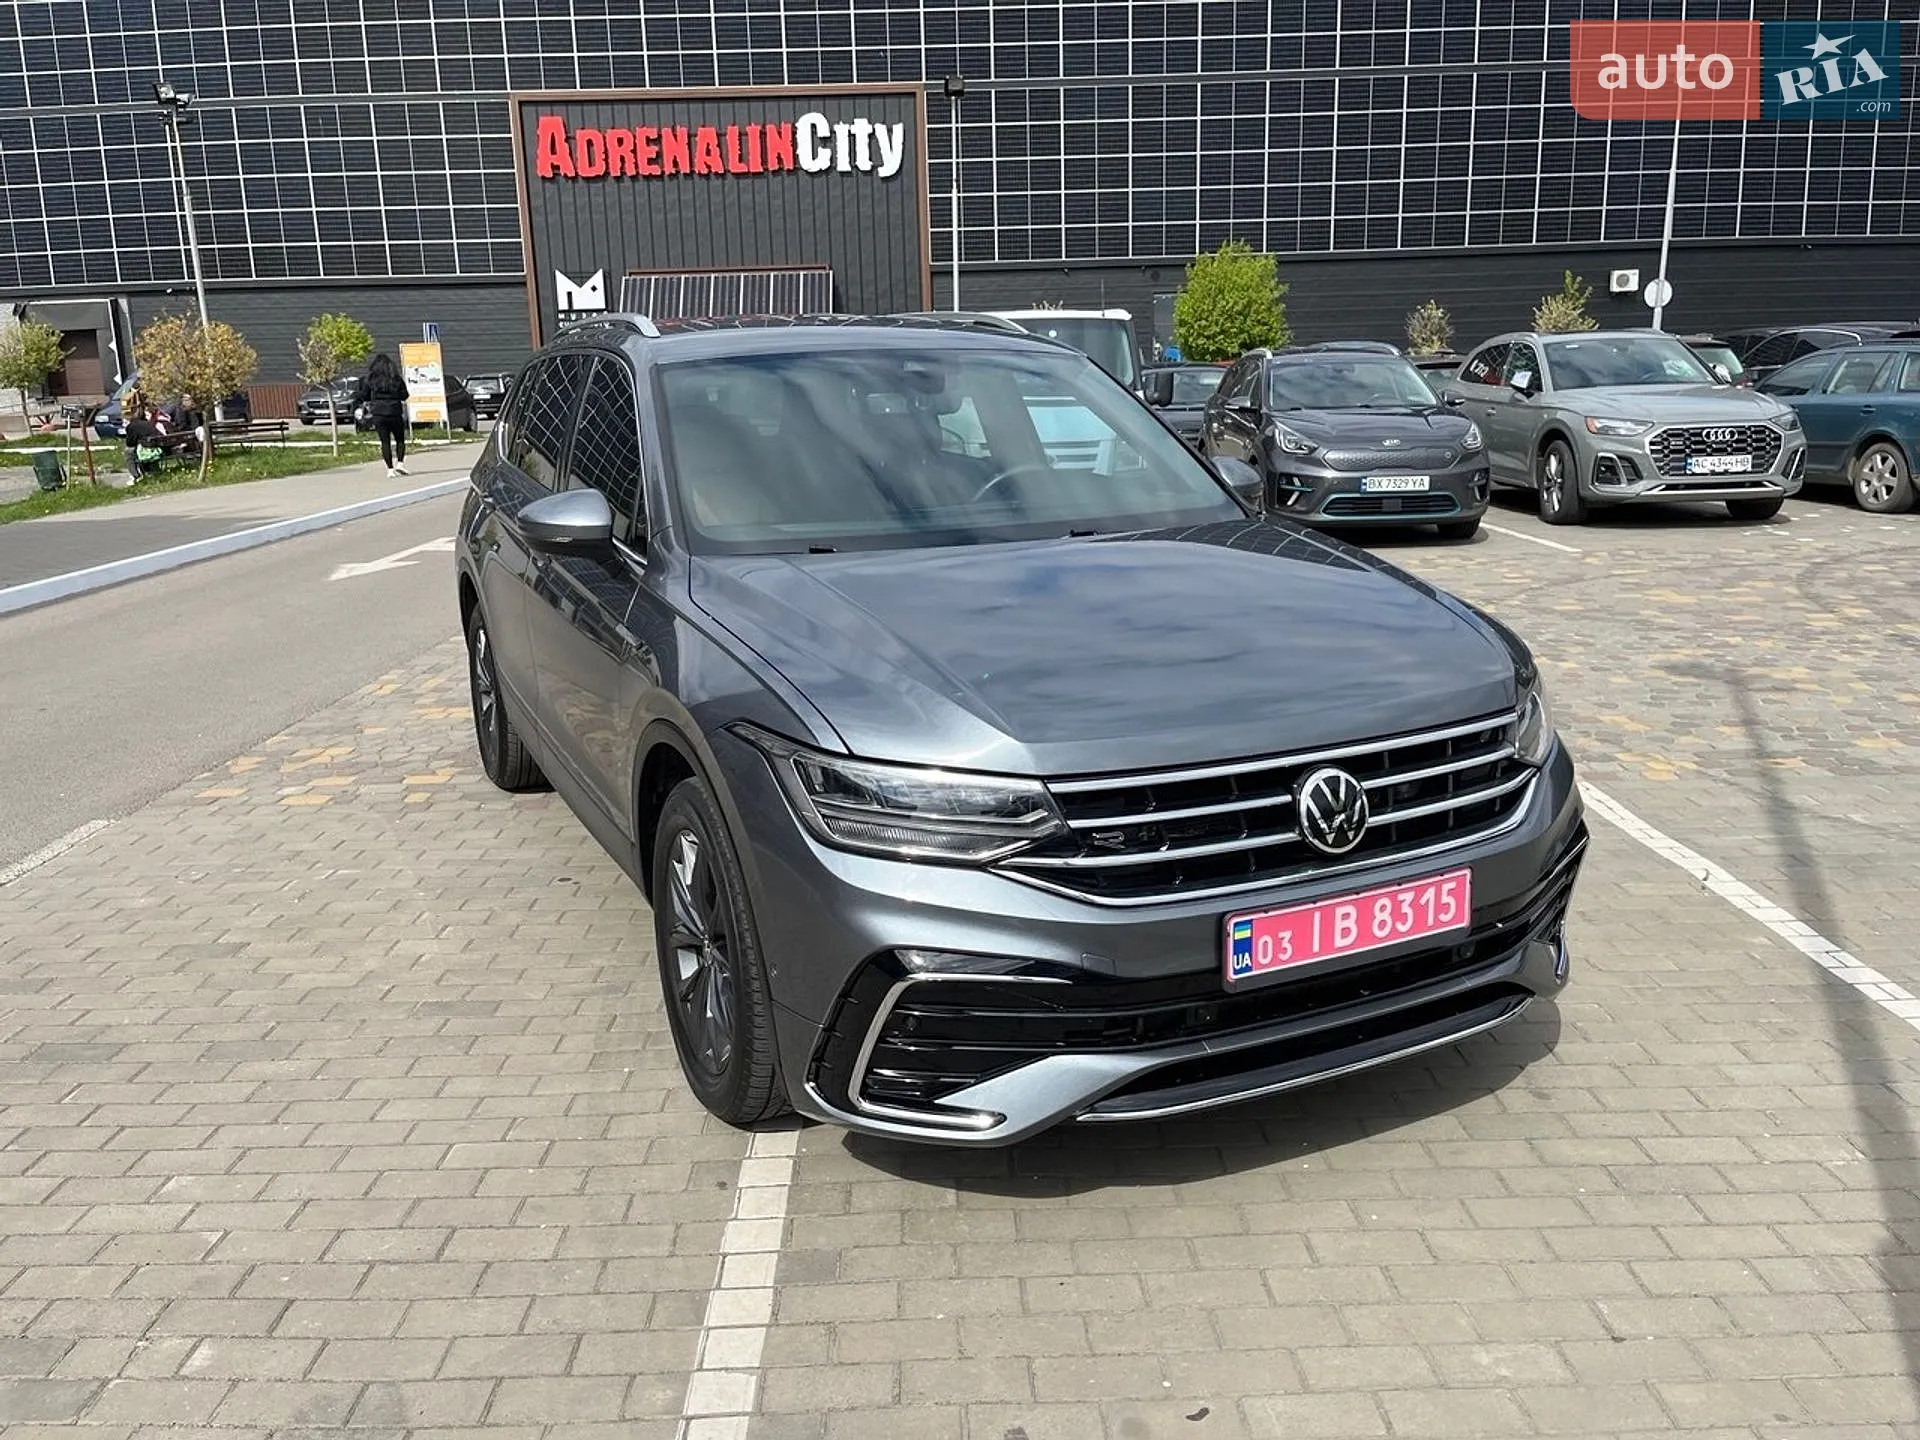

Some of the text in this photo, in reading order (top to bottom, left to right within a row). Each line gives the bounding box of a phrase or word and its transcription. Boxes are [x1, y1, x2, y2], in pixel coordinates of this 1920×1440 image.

[1368, 478, 1383, 489] BX
[1386, 478, 1409, 489] 7329
[1257, 881, 1457, 965] 03 IB 8315
[1233, 952, 1252, 970] UA
